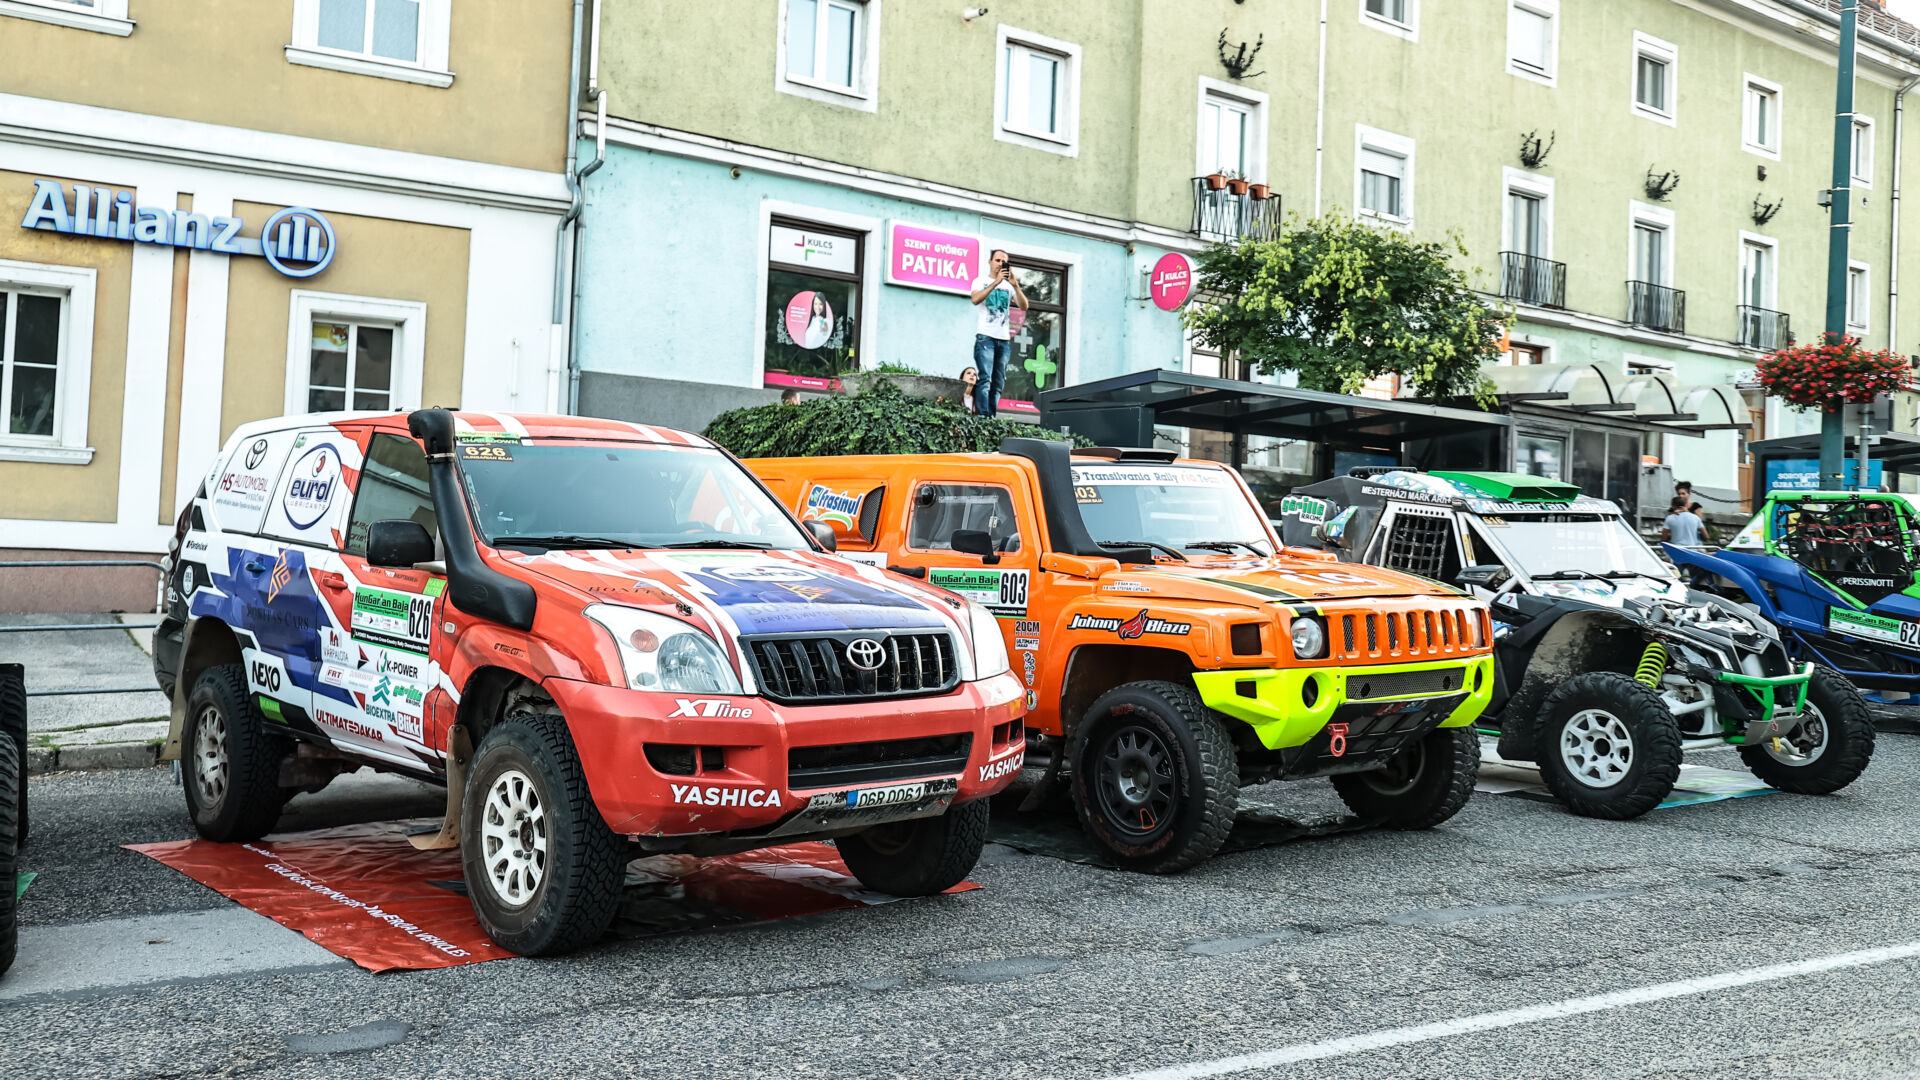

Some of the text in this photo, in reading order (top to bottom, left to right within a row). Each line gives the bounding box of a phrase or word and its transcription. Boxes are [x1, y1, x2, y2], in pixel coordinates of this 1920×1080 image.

[21, 178, 245, 254] Allianz
[808, 237, 833, 250] KULCS
[904, 238, 931, 251] SZENT
[901, 252, 969, 281] PATIKA
[1165, 270, 1187, 281] KULCS
[465, 446, 506, 457] 626
[219, 472, 269, 492] HS AUTOMOBIL
[1082, 471, 1150, 481] Transilvania
[1153, 472, 1178, 483] Rally
[289, 474, 335, 503] eurol
[1074, 487, 1097, 499] 03
[1361, 485, 1407, 499] MESTERHÁZI
[1282, 497, 1325, 516] gorilla
[1301, 513, 1322, 522] RACING
[1481, 516, 1504, 524] 616
[978, 575, 1000, 585] Baja
[1000, 572, 1027, 605] 603
[1843, 577, 1894, 588] PERISSINOTTI
[392, 599, 409, 612] Baja
[408, 598, 432, 640] 626
[1015, 620, 1040, 632] 20CM
[1067, 614, 1192, 635] Johnny Blaze
[1878, 620, 1900, 629] Baja
[1900, 621, 1920, 645] 62
[252, 660, 281, 692] NEXO
[327, 669, 342, 679] FRT
[386, 660, 418, 679] K-POWER
[365, 703, 397, 723] BIOEXTRA
[397, 711, 421, 738] Blikk
[978, 750, 1024, 782] YASHICA
[670, 783, 782, 808] YASHICA
[415, 931, 472, 958] VEHICLES
